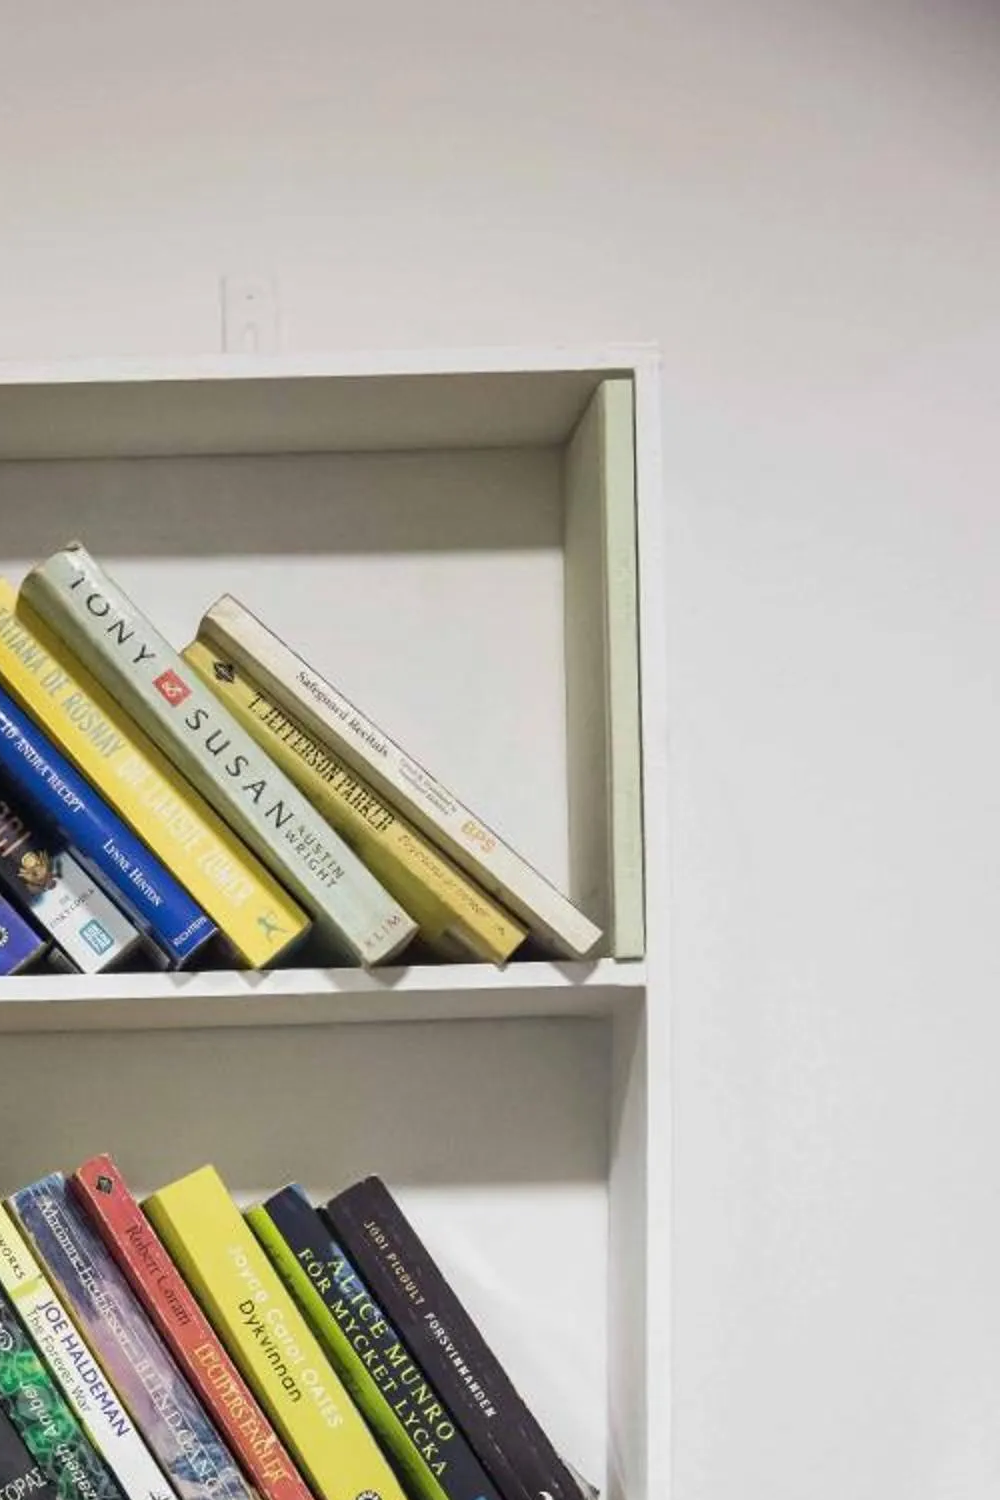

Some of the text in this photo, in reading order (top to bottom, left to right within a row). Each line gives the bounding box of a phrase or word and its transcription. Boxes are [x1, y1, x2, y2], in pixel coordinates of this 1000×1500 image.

[37, 665, 72, 700] DE
[57, 688, 127, 763] ROSNAY
[64, 571, 159, 672] TONY
[181, 704, 299, 832] SUSAN
[43, 771, 88, 817] RECEPT
[257, 700, 344, 785] JEFFERSON
[332, 770, 398, 836] PARKER
[280, 827, 340, 893] WRIGHT
[121, 1220, 170, 1281] Robert
[361, 1217, 428, 1308] JODI PICOULT
[23, 1306, 95, 1416] The Forever War
[35, 1295, 132, 1441] JOE HALDEMAN
[223, 1239, 346, 1432] Joyce Carol OATES
[233, 1296, 307, 1406] Dykvinnan
[323, 1252, 460, 1444] ALICE MUNRO
[327, 1297, 401, 1396] MYCKET
[390, 1397, 454, 1479] LYCKA
[11, 1375, 65, 1441] Amber
